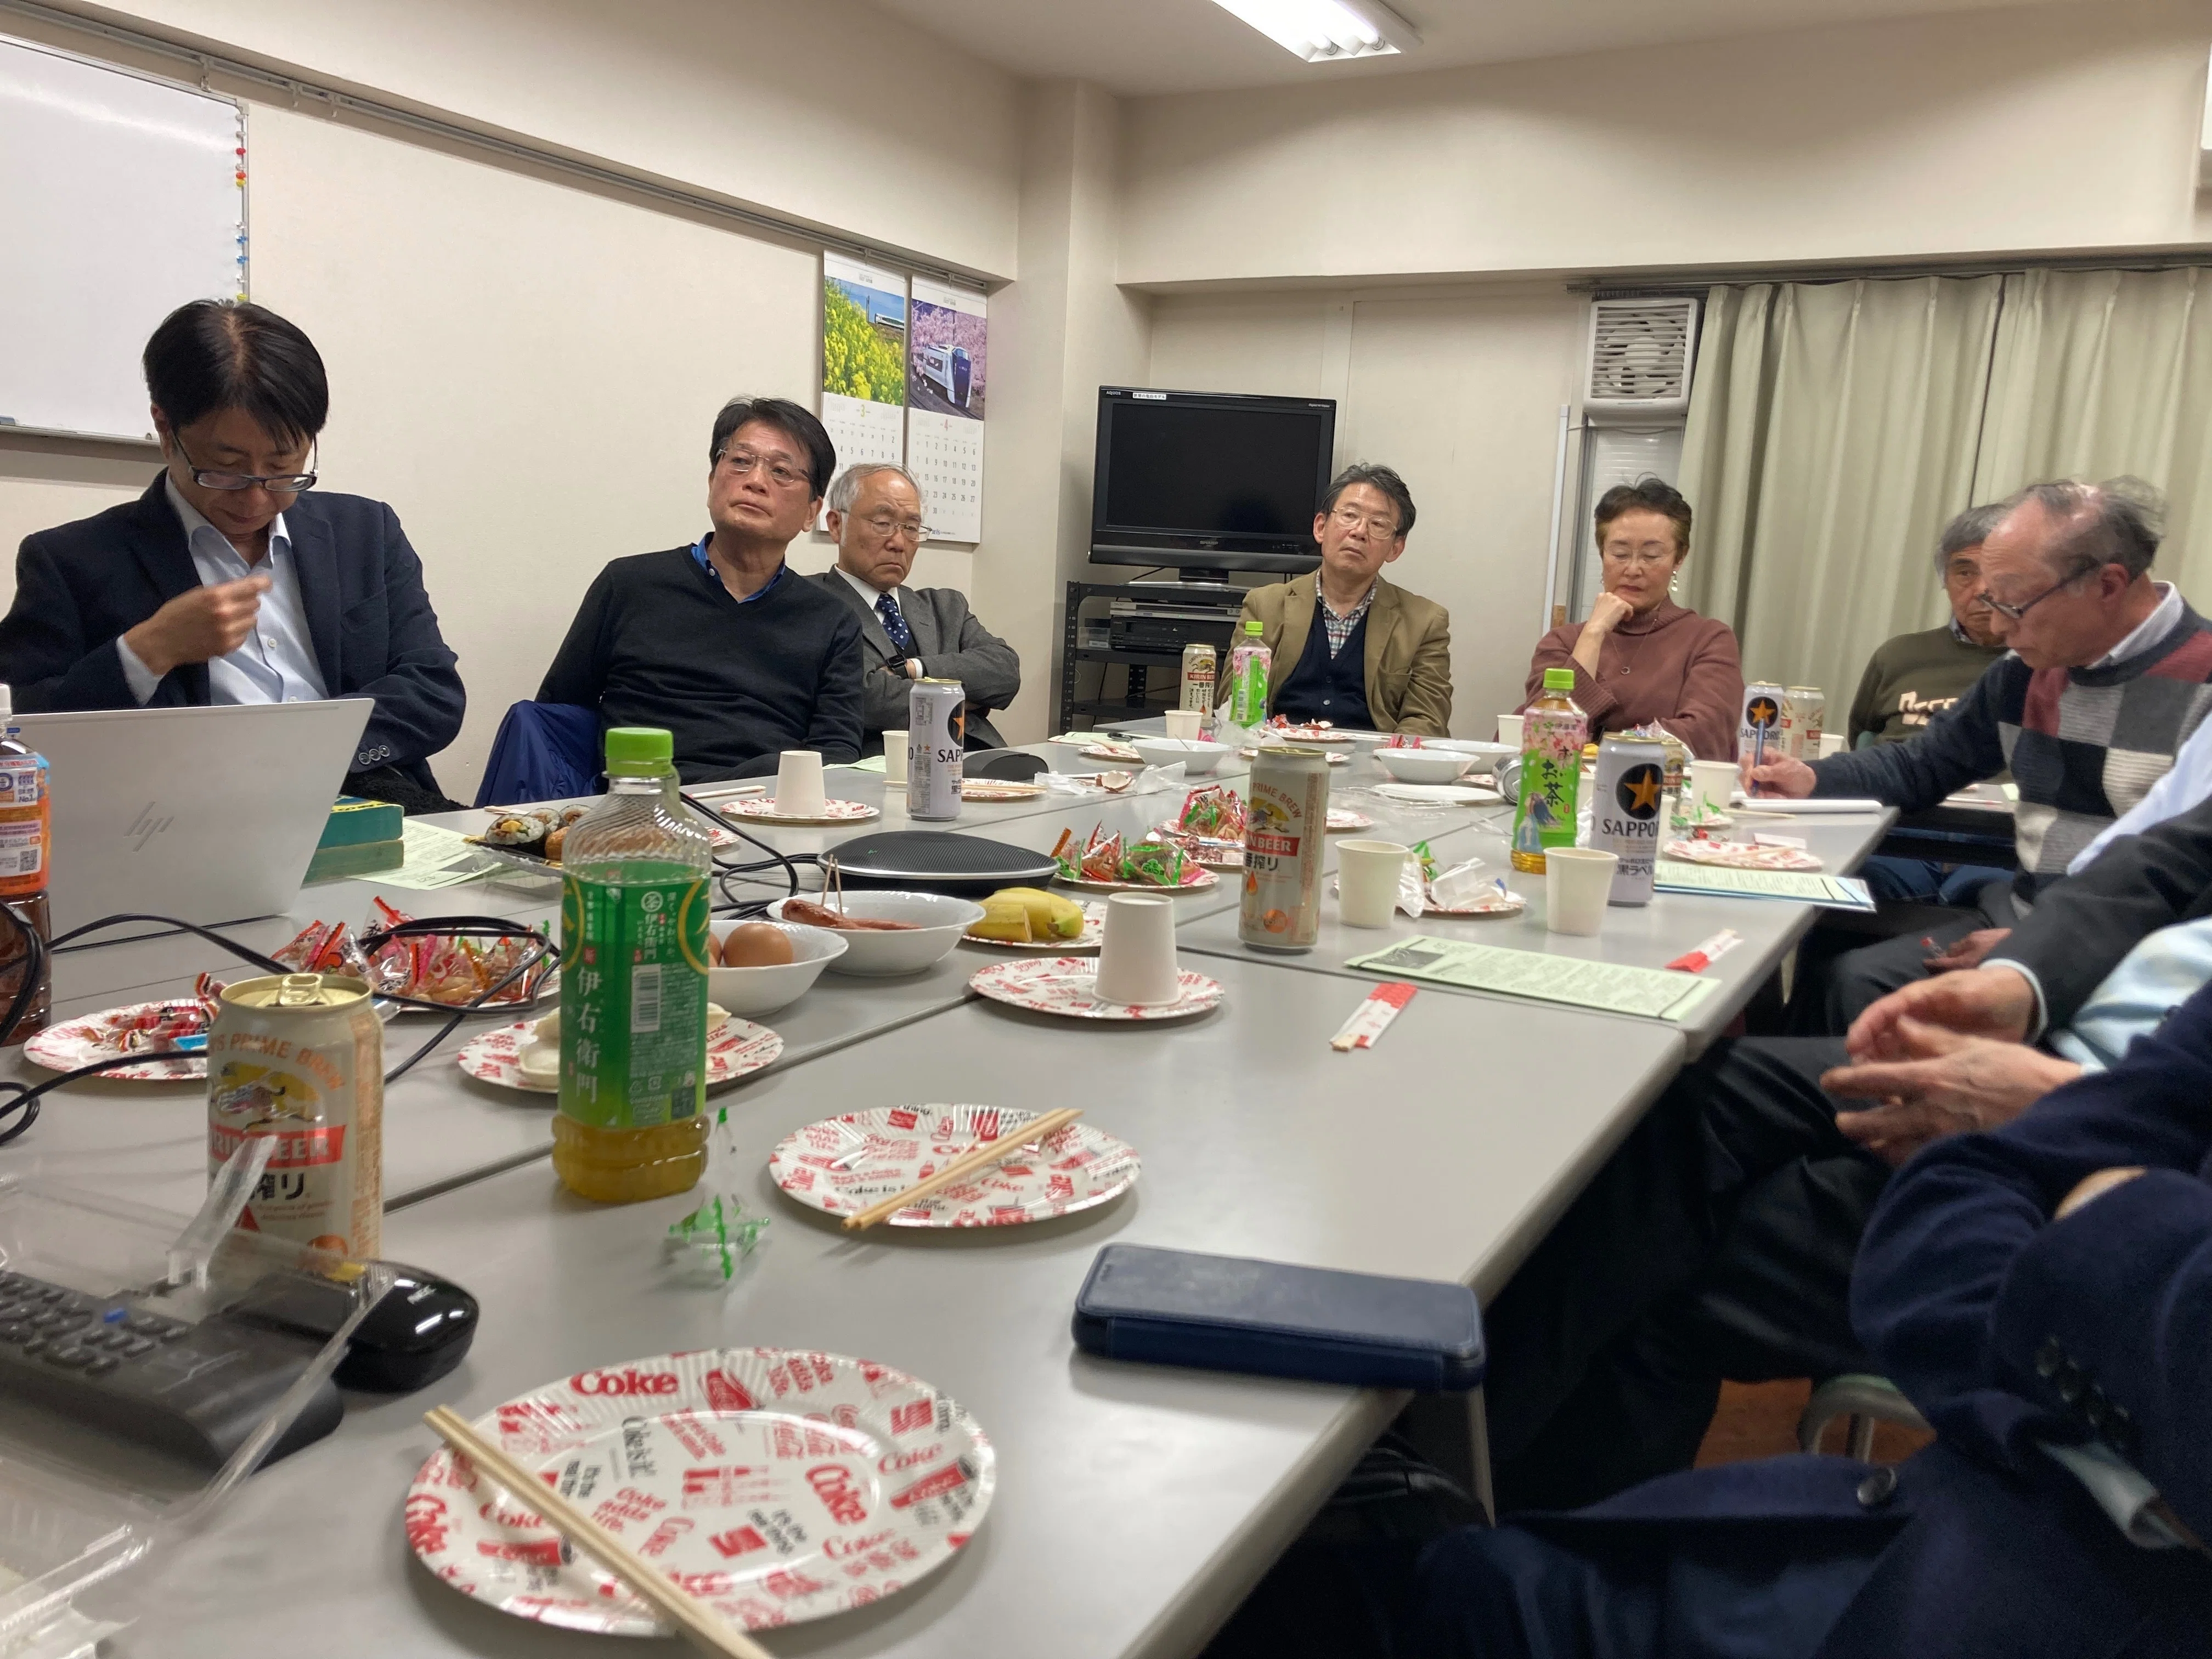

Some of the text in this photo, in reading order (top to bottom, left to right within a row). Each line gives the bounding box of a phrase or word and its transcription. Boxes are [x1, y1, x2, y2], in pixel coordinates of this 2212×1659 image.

[860, 404, 866, 417] 3
[944, 419, 948, 431] 4
[1740, 728, 1780, 740] SAPORO
[1541, 759, 1564, 807] お茶
[1252, 782, 1302, 818] PRIME BREW
[1257, 838, 1291, 851] BEER
[1616, 864, 1652, 876] 黒ラベル
[577, 966, 602, 1105] 伊右衛門
[274, 1137, 327, 1160] EER
[249, 1172, 305, 1201] 搾り
[569, 1369, 679, 1396] Coke
[805, 1462, 867, 1526] Coke
